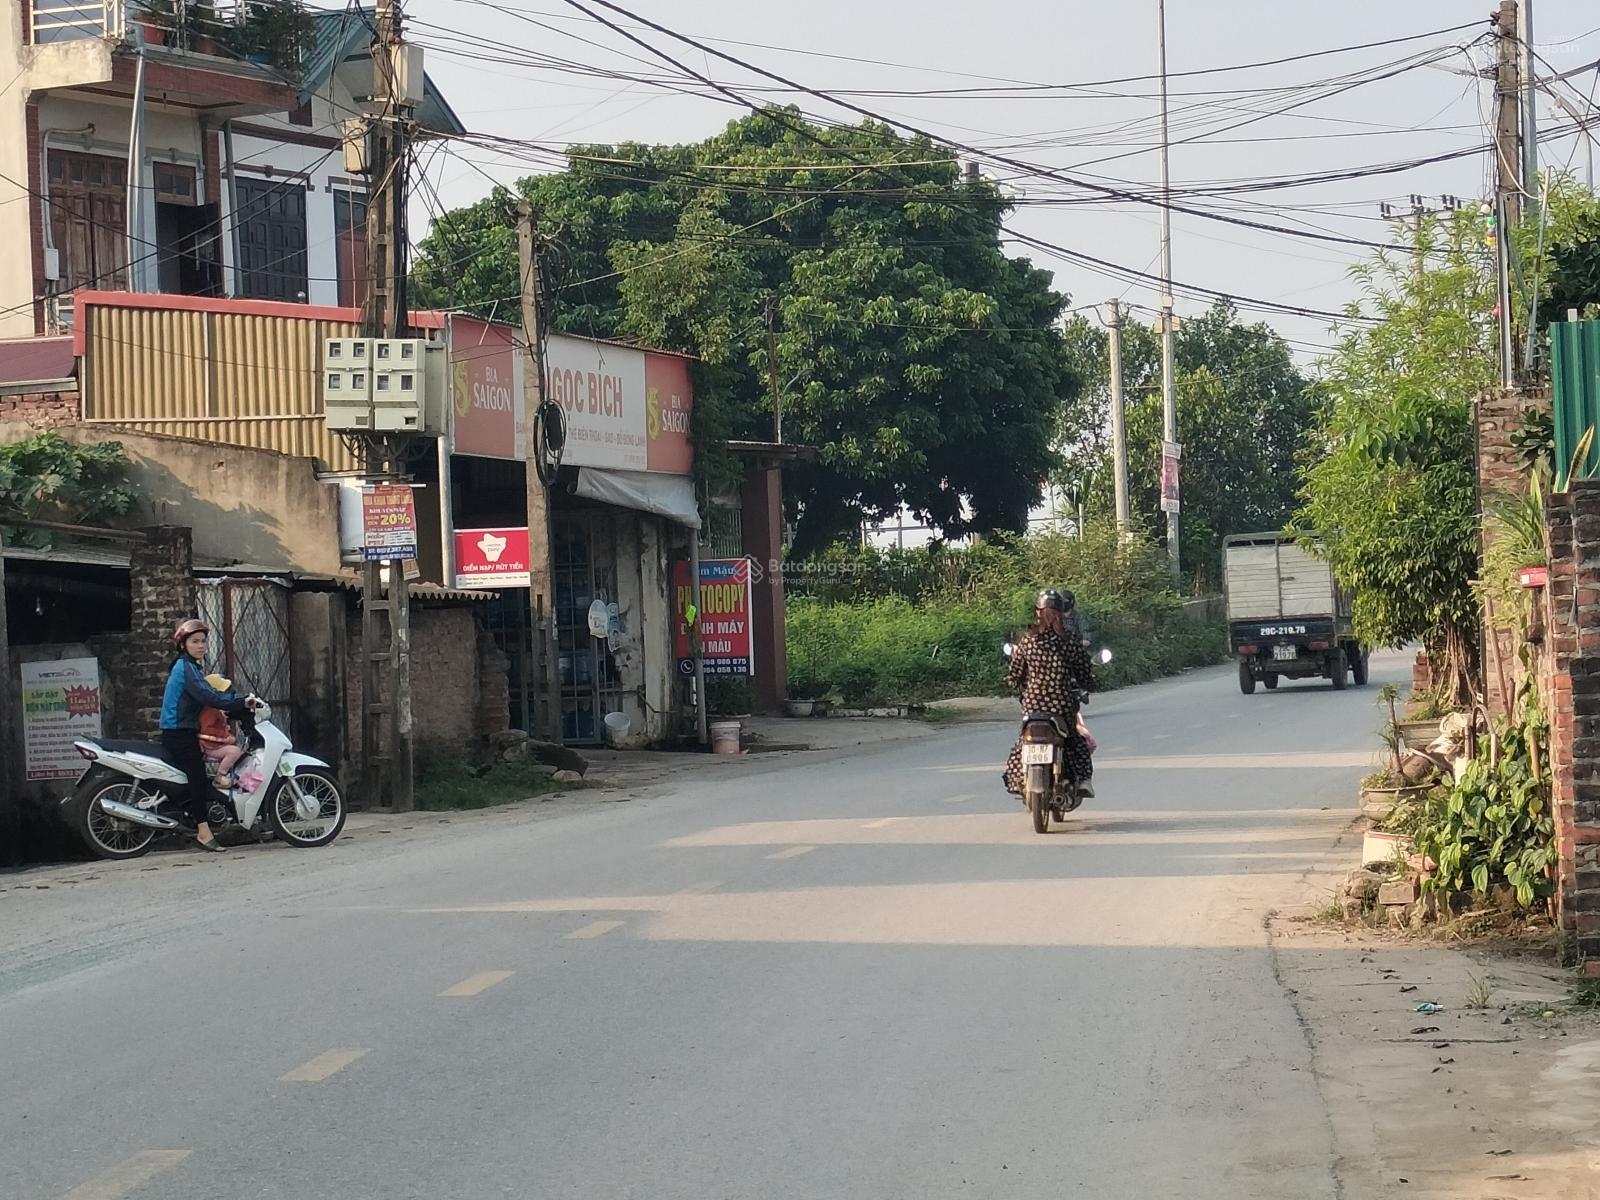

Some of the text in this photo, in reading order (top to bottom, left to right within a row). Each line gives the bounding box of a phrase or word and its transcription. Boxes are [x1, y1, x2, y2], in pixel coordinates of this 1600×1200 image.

[486, 366, 498, 382] BIA
[473, 382, 511, 411] SAIGON
[588, 360, 624, 418] BÍCH
[671, 395, 681, 409] BIA
[380, 513, 411, 526] 20%
[677, 583, 745, 614] PHTOCOPY
[718, 619, 744, 635] MÁY
[708, 638, 731, 653] MÀU
